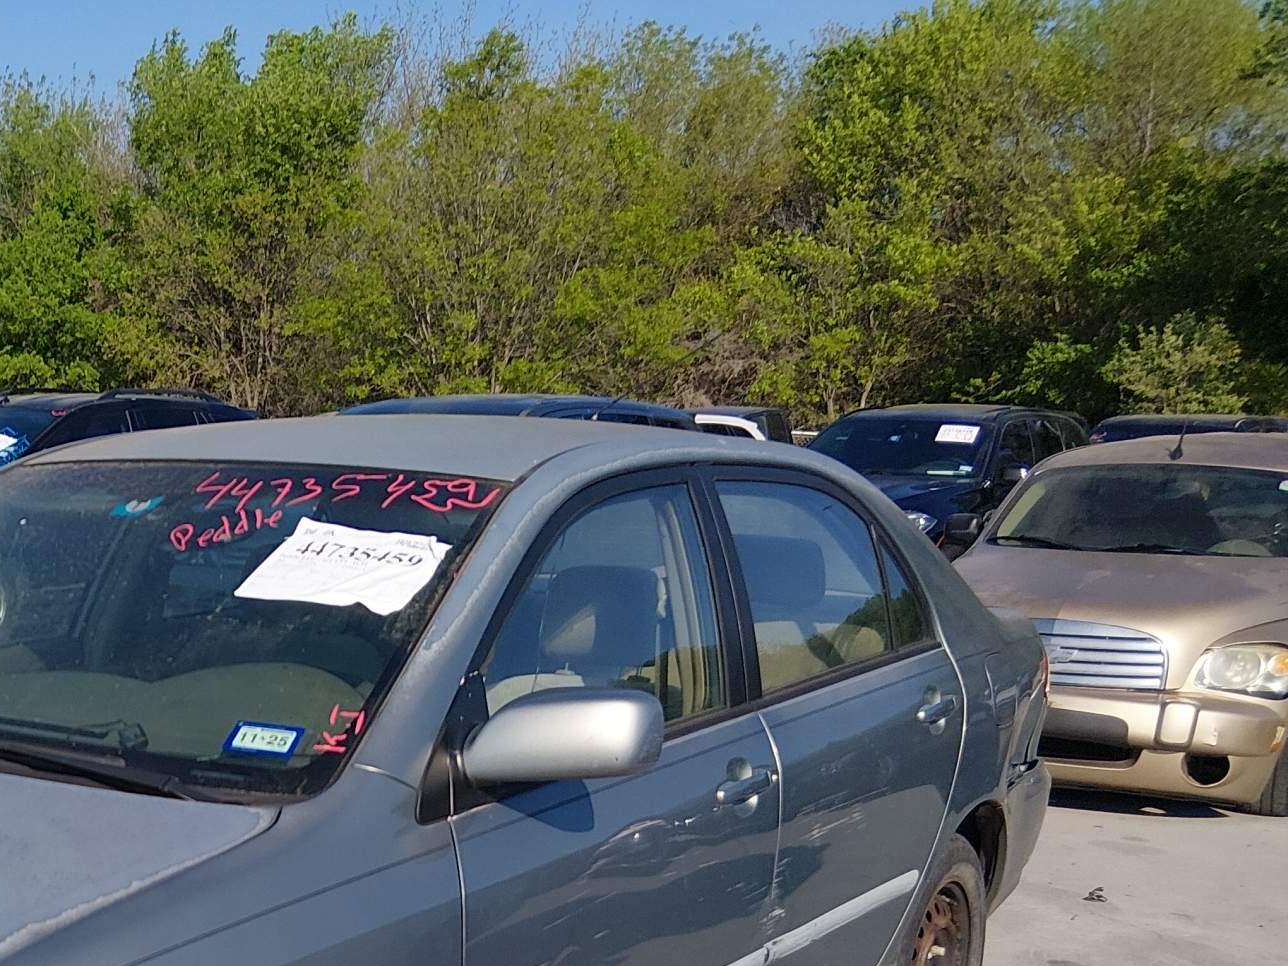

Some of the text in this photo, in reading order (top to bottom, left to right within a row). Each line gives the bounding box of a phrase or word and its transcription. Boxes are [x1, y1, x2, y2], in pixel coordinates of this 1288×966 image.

[196, 471, 501, 513] 44735459
[169, 507, 284, 551] Peddle
[295, 541, 423, 566] 44735459
